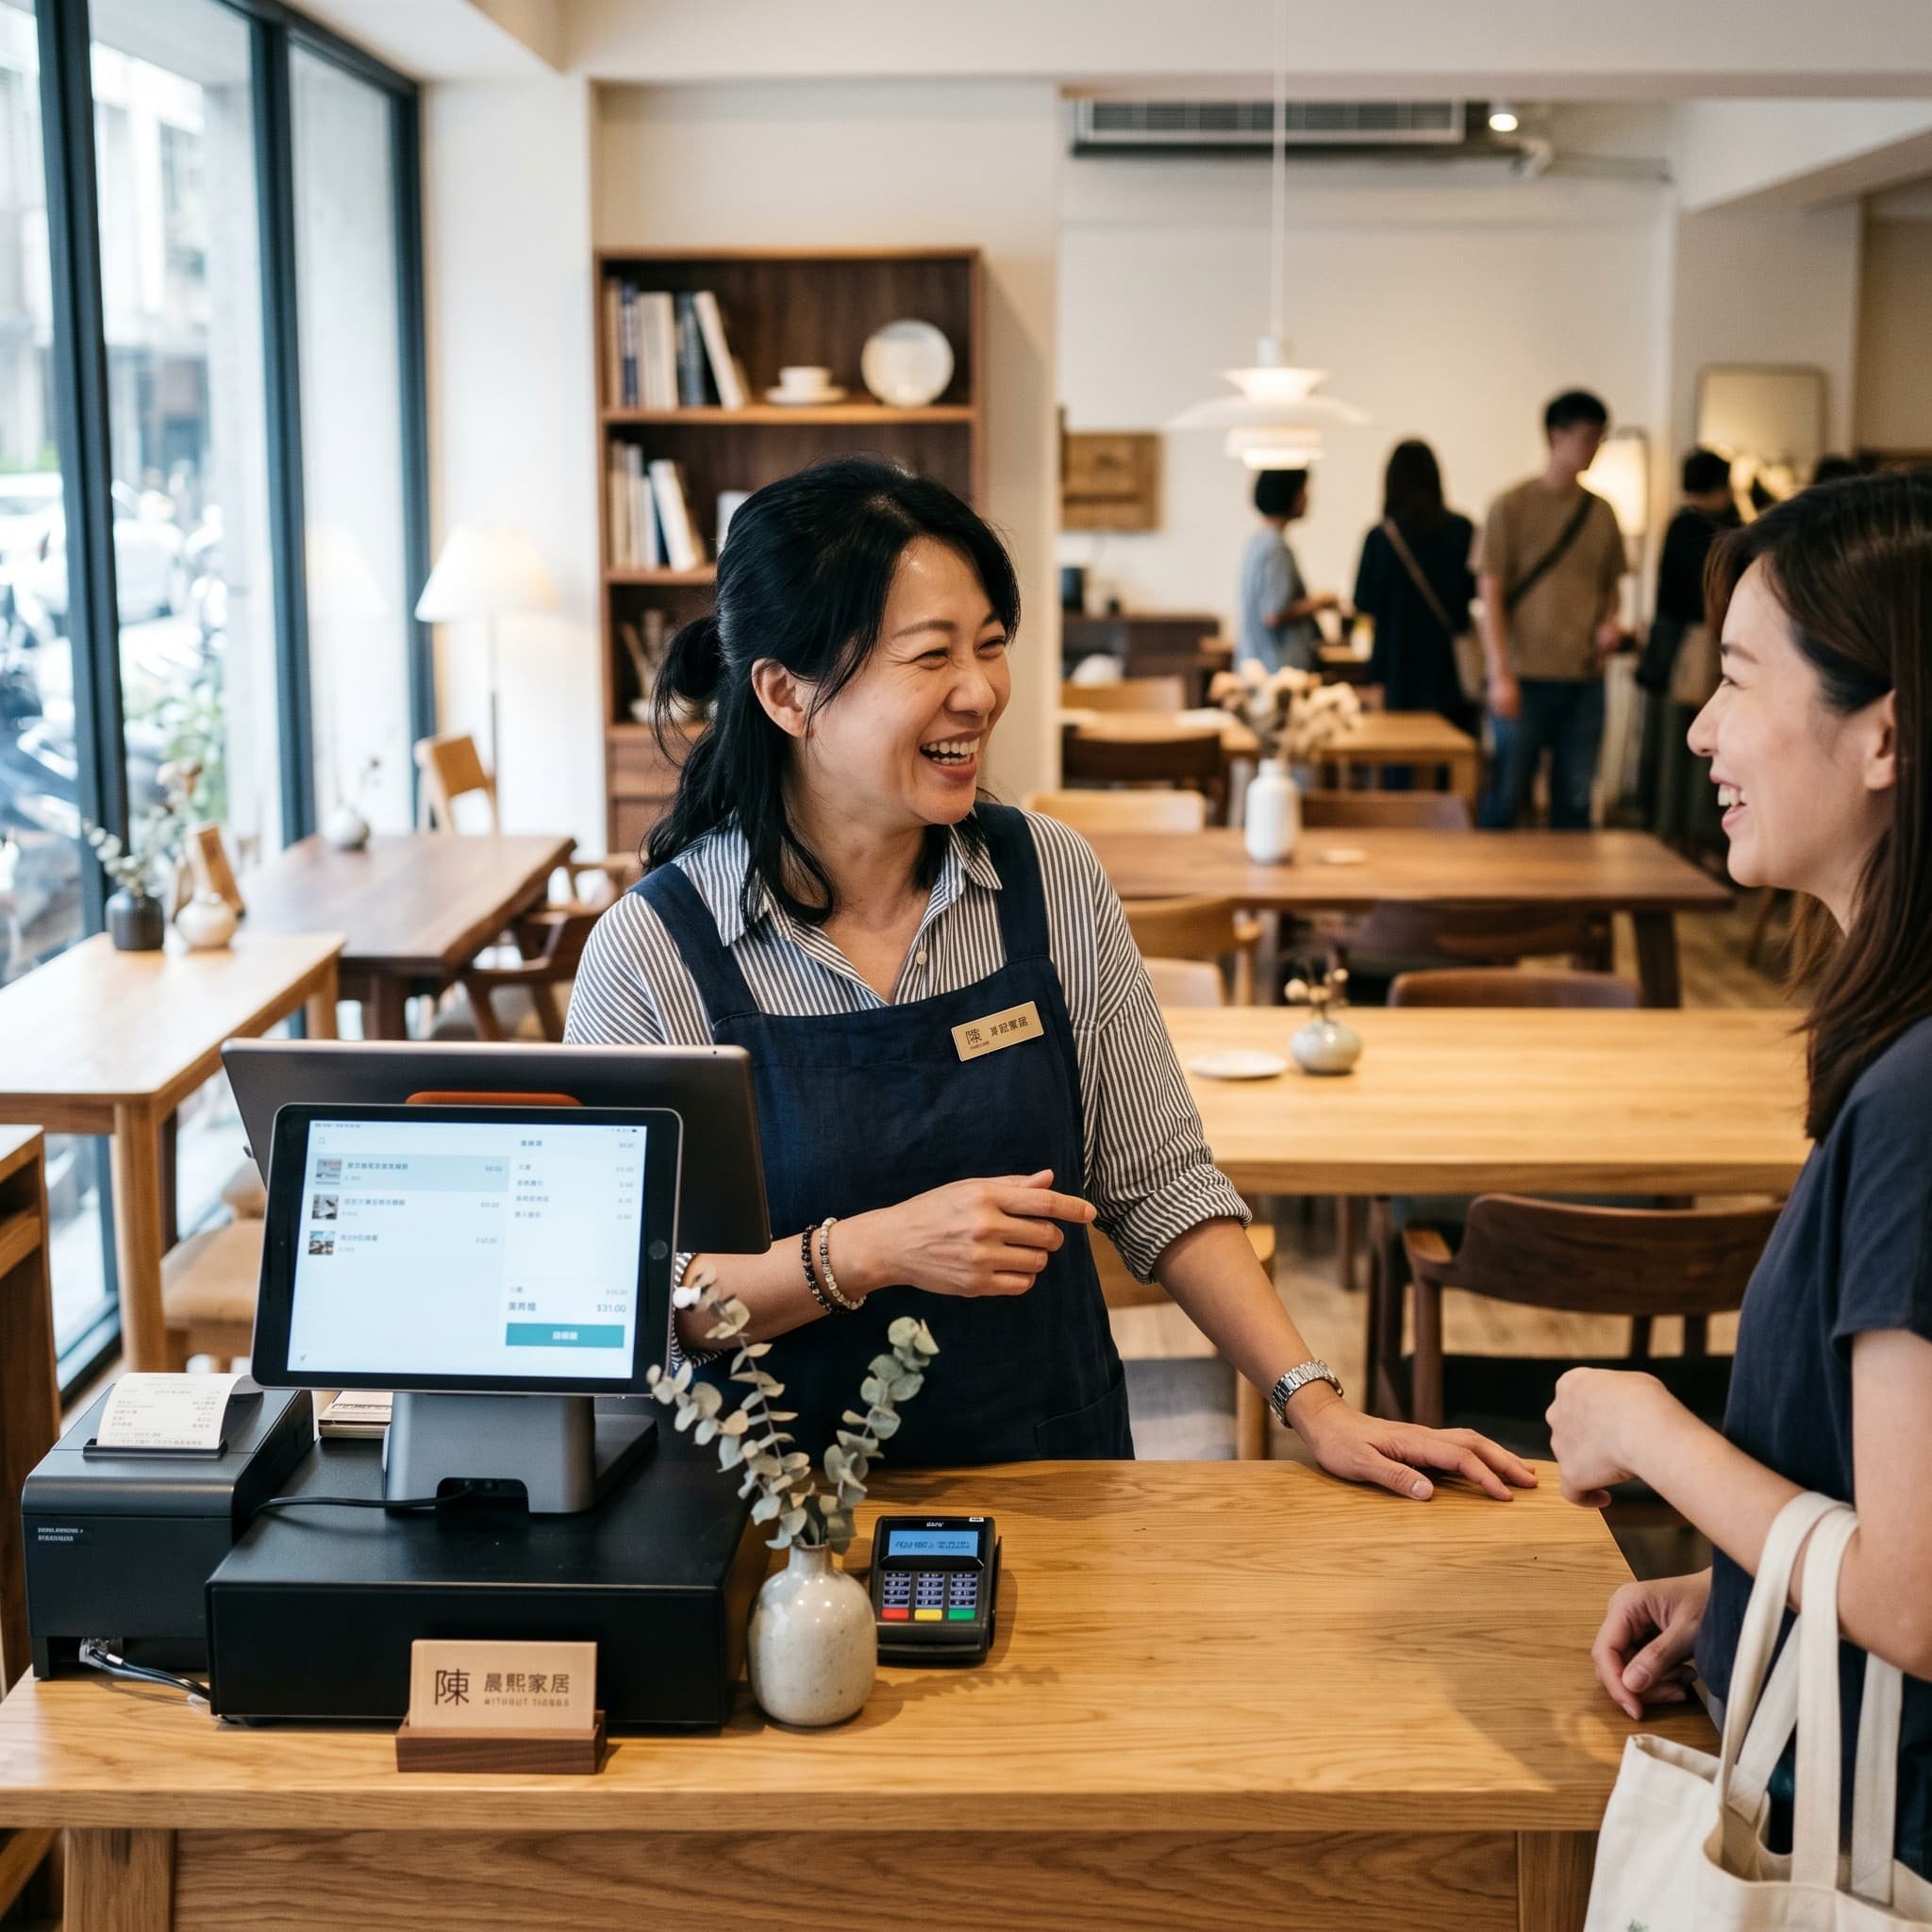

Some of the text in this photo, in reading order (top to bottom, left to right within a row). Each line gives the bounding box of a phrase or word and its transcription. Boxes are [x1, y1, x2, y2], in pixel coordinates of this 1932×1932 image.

[435, 1668, 570, 1706] 陳 晨熙家居
